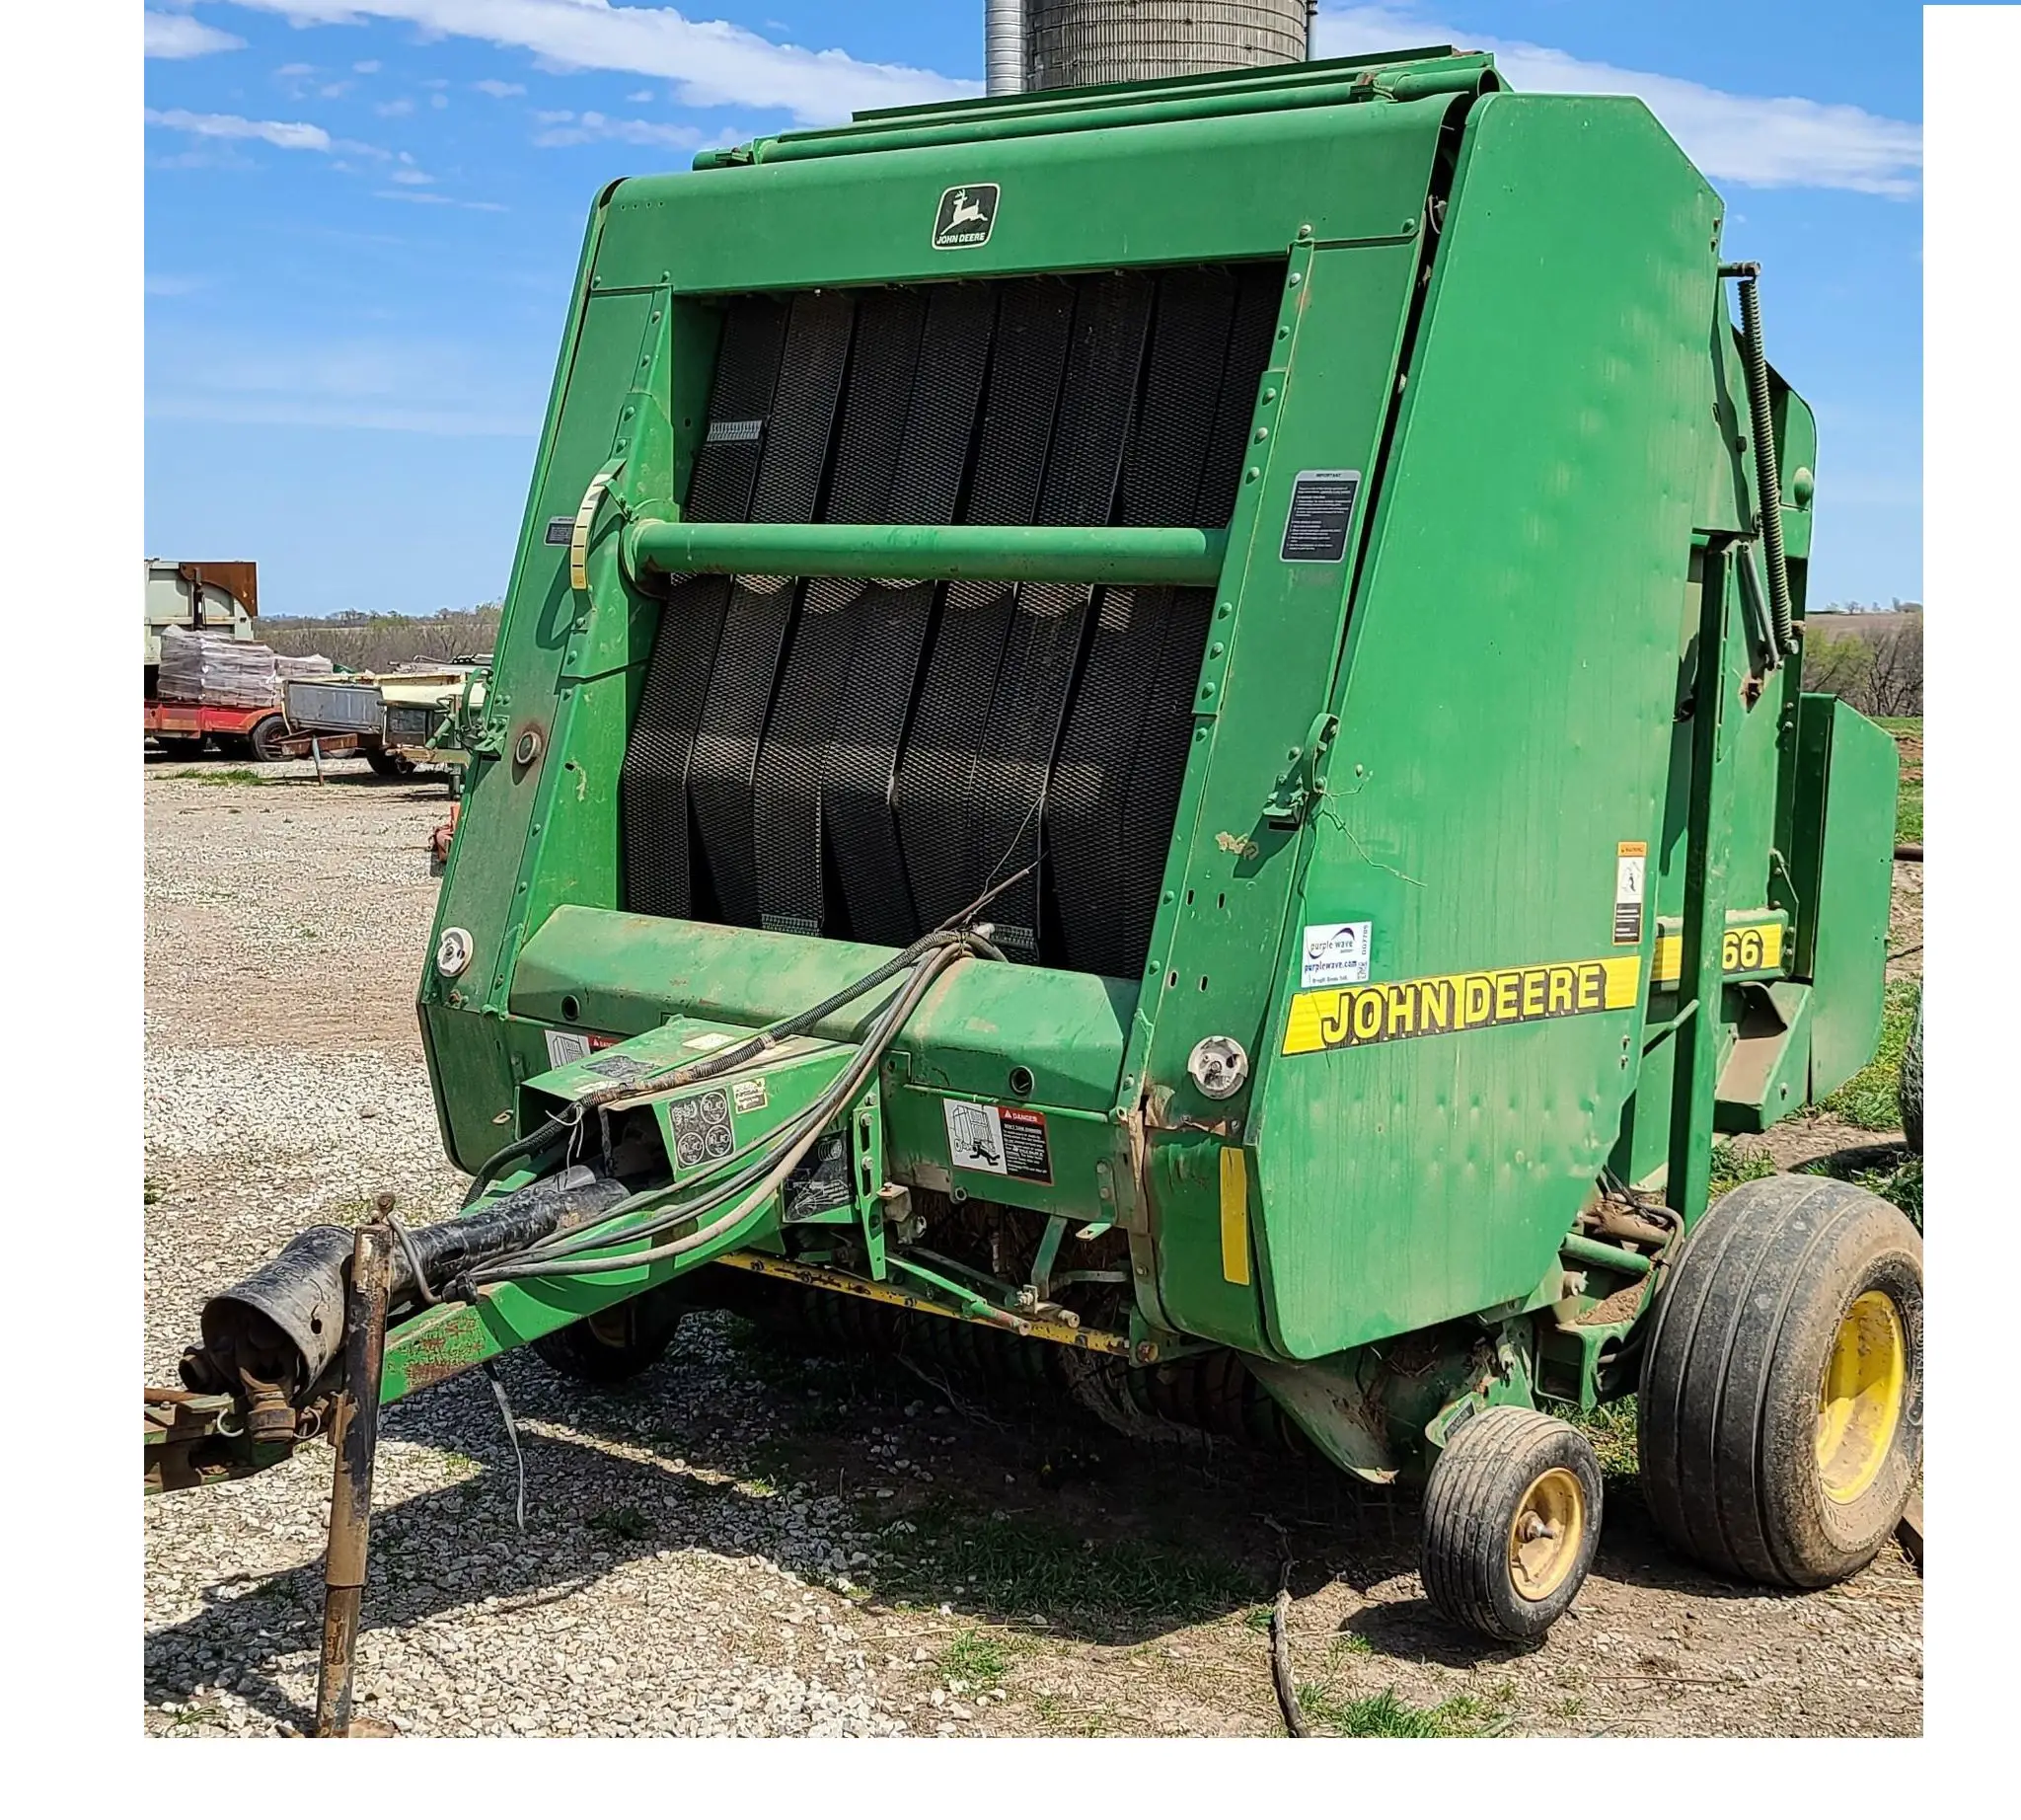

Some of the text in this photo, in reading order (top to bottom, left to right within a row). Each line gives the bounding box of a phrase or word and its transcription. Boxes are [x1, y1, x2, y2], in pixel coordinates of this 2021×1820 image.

[936, 232, 985, 244] JOHN DEERE
[1310, 941, 1333, 951] purple
[1304, 960, 1357, 974] purplewave.com
[1321, 963, 1606, 1047] JOHN DEERE
[1012, 1113, 1037, 1122] DANGER
